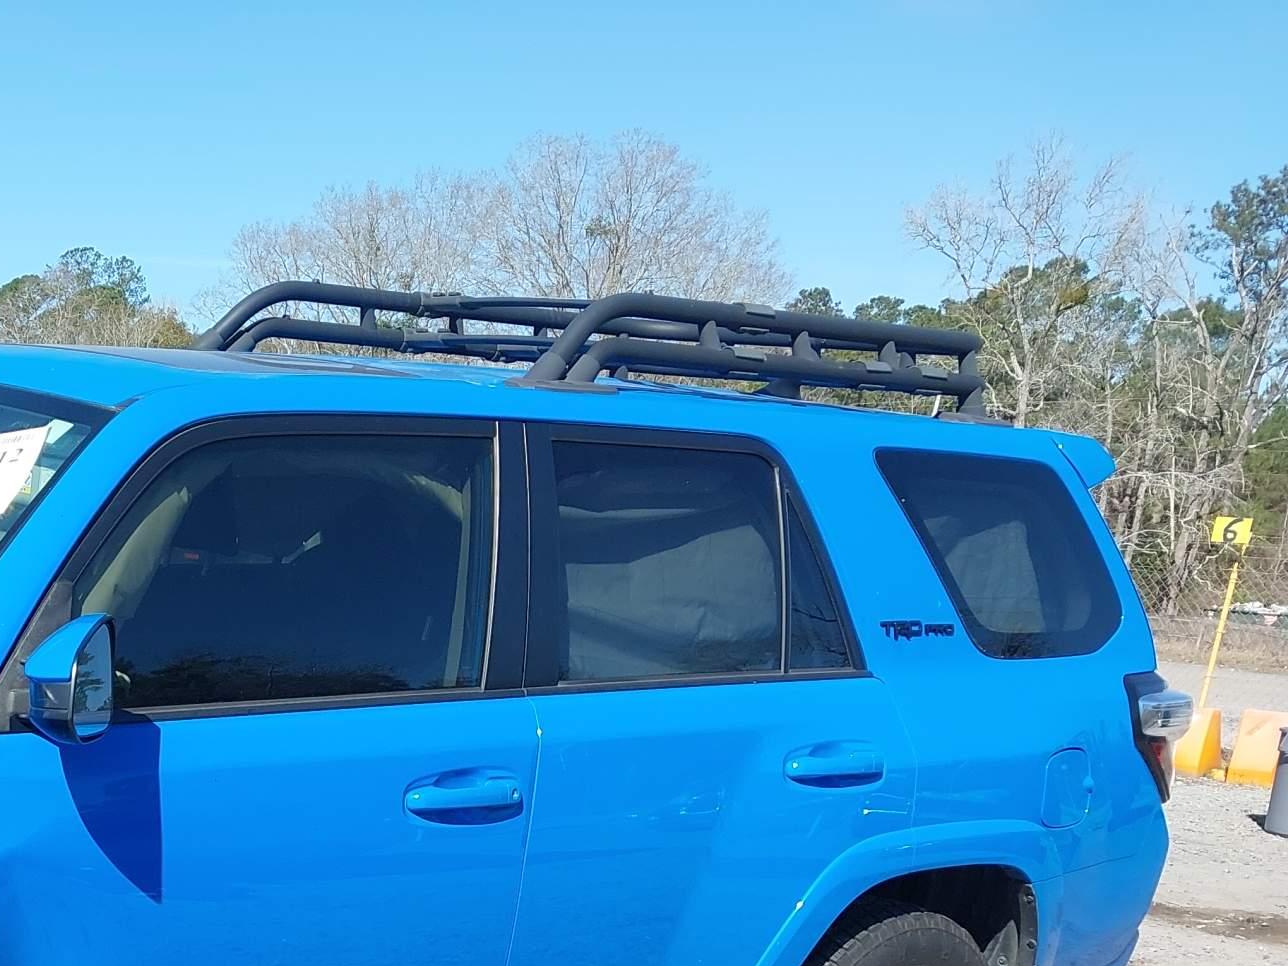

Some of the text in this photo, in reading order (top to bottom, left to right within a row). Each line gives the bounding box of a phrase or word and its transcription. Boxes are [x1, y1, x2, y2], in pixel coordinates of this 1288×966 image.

[1222, 517, 1244, 542] 6
[880, 620, 955, 641] TRD PRO
